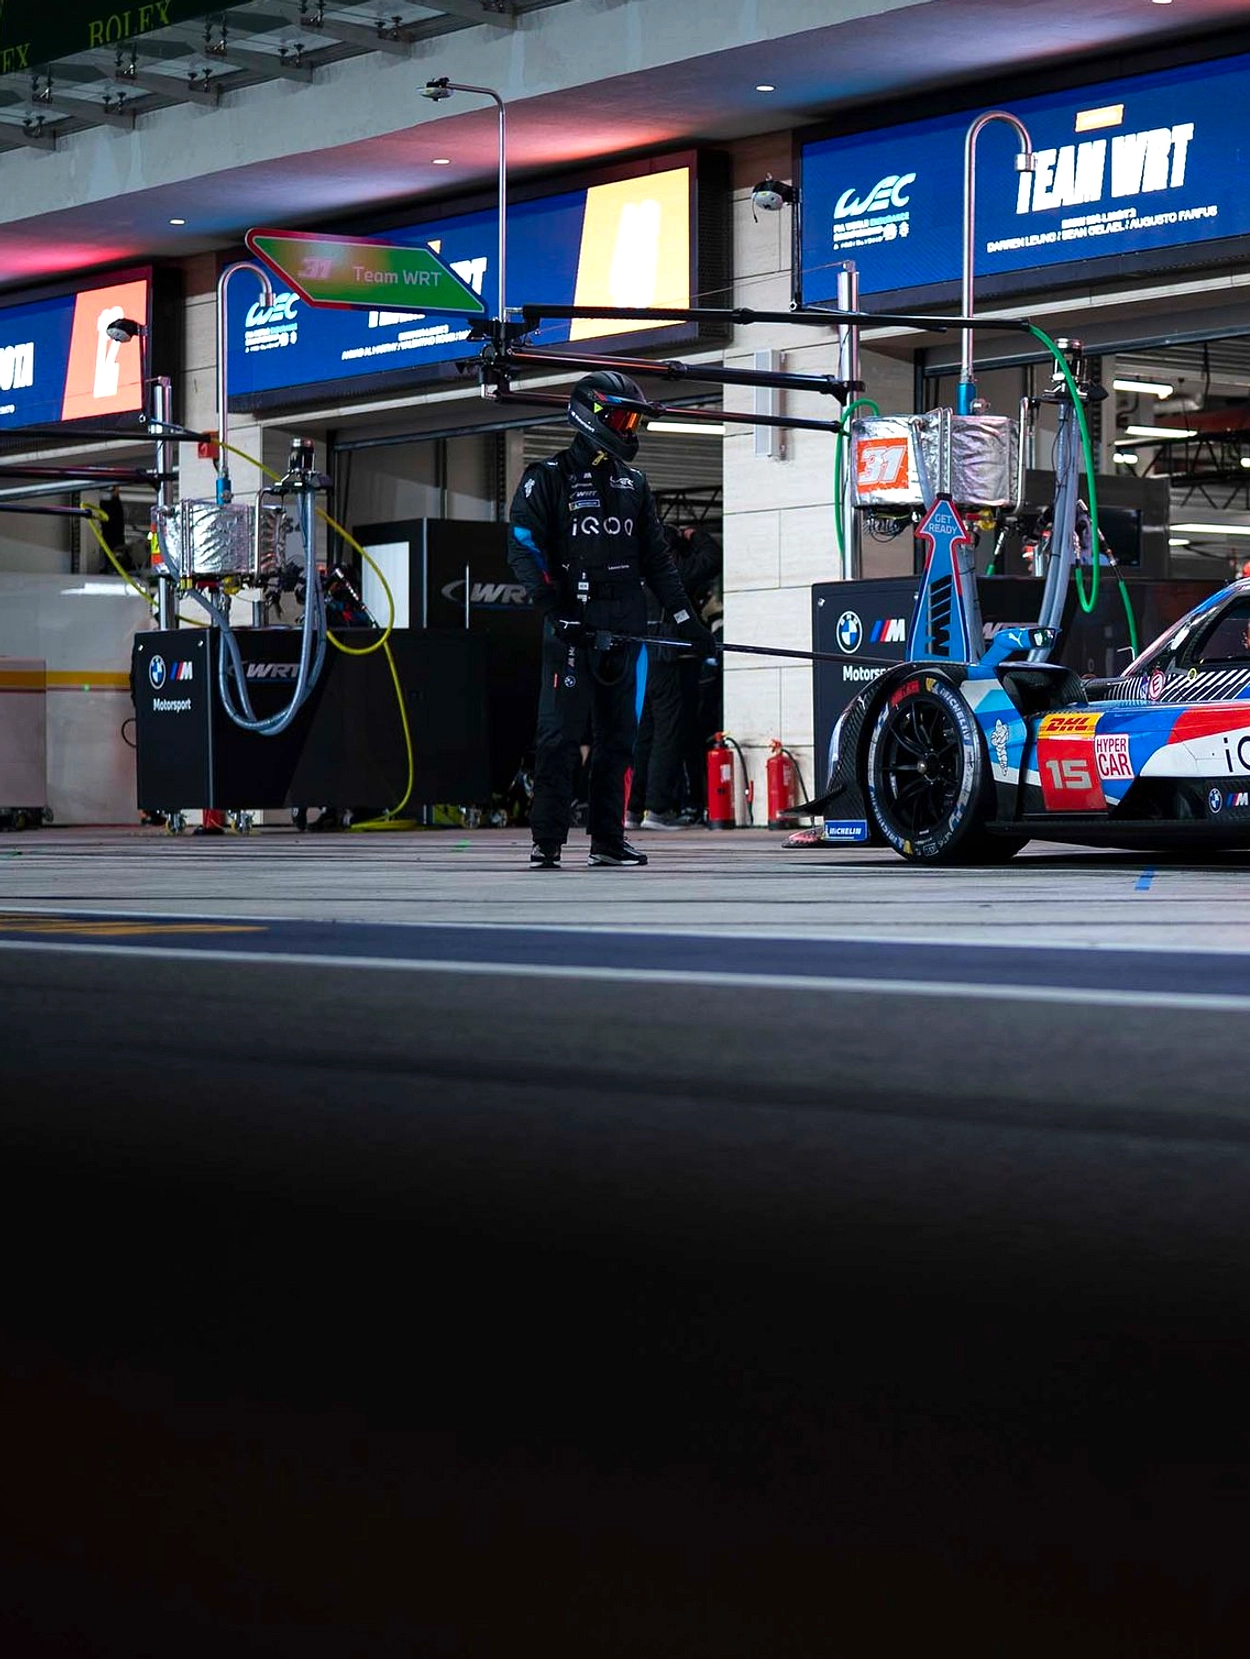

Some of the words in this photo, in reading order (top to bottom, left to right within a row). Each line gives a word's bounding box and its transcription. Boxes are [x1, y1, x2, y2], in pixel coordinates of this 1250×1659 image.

[89, 0, 170, 47] ROLEX
[1016, 139, 1107, 214] TEAM
[1111, 122, 1195, 198] WRT
[833, 172, 917, 219] WEC
[353, 266, 398, 284] Team
[402, 269, 442, 287] WRT
[859, 445, 907, 485] 31
[929, 522, 958, 535] READY
[934, 513, 952, 524] GET
[469, 583, 534, 604] WR
[246, 663, 300, 678] WRT
[843, 665, 890, 681] Motors
[153, 697, 191, 713] Motorsport
[1046, 717, 1089, 731] DHL
[1097, 738, 1126, 753] HYPER
[1046, 760, 1092, 789] 15
[1099, 753, 1131, 776] CAR
